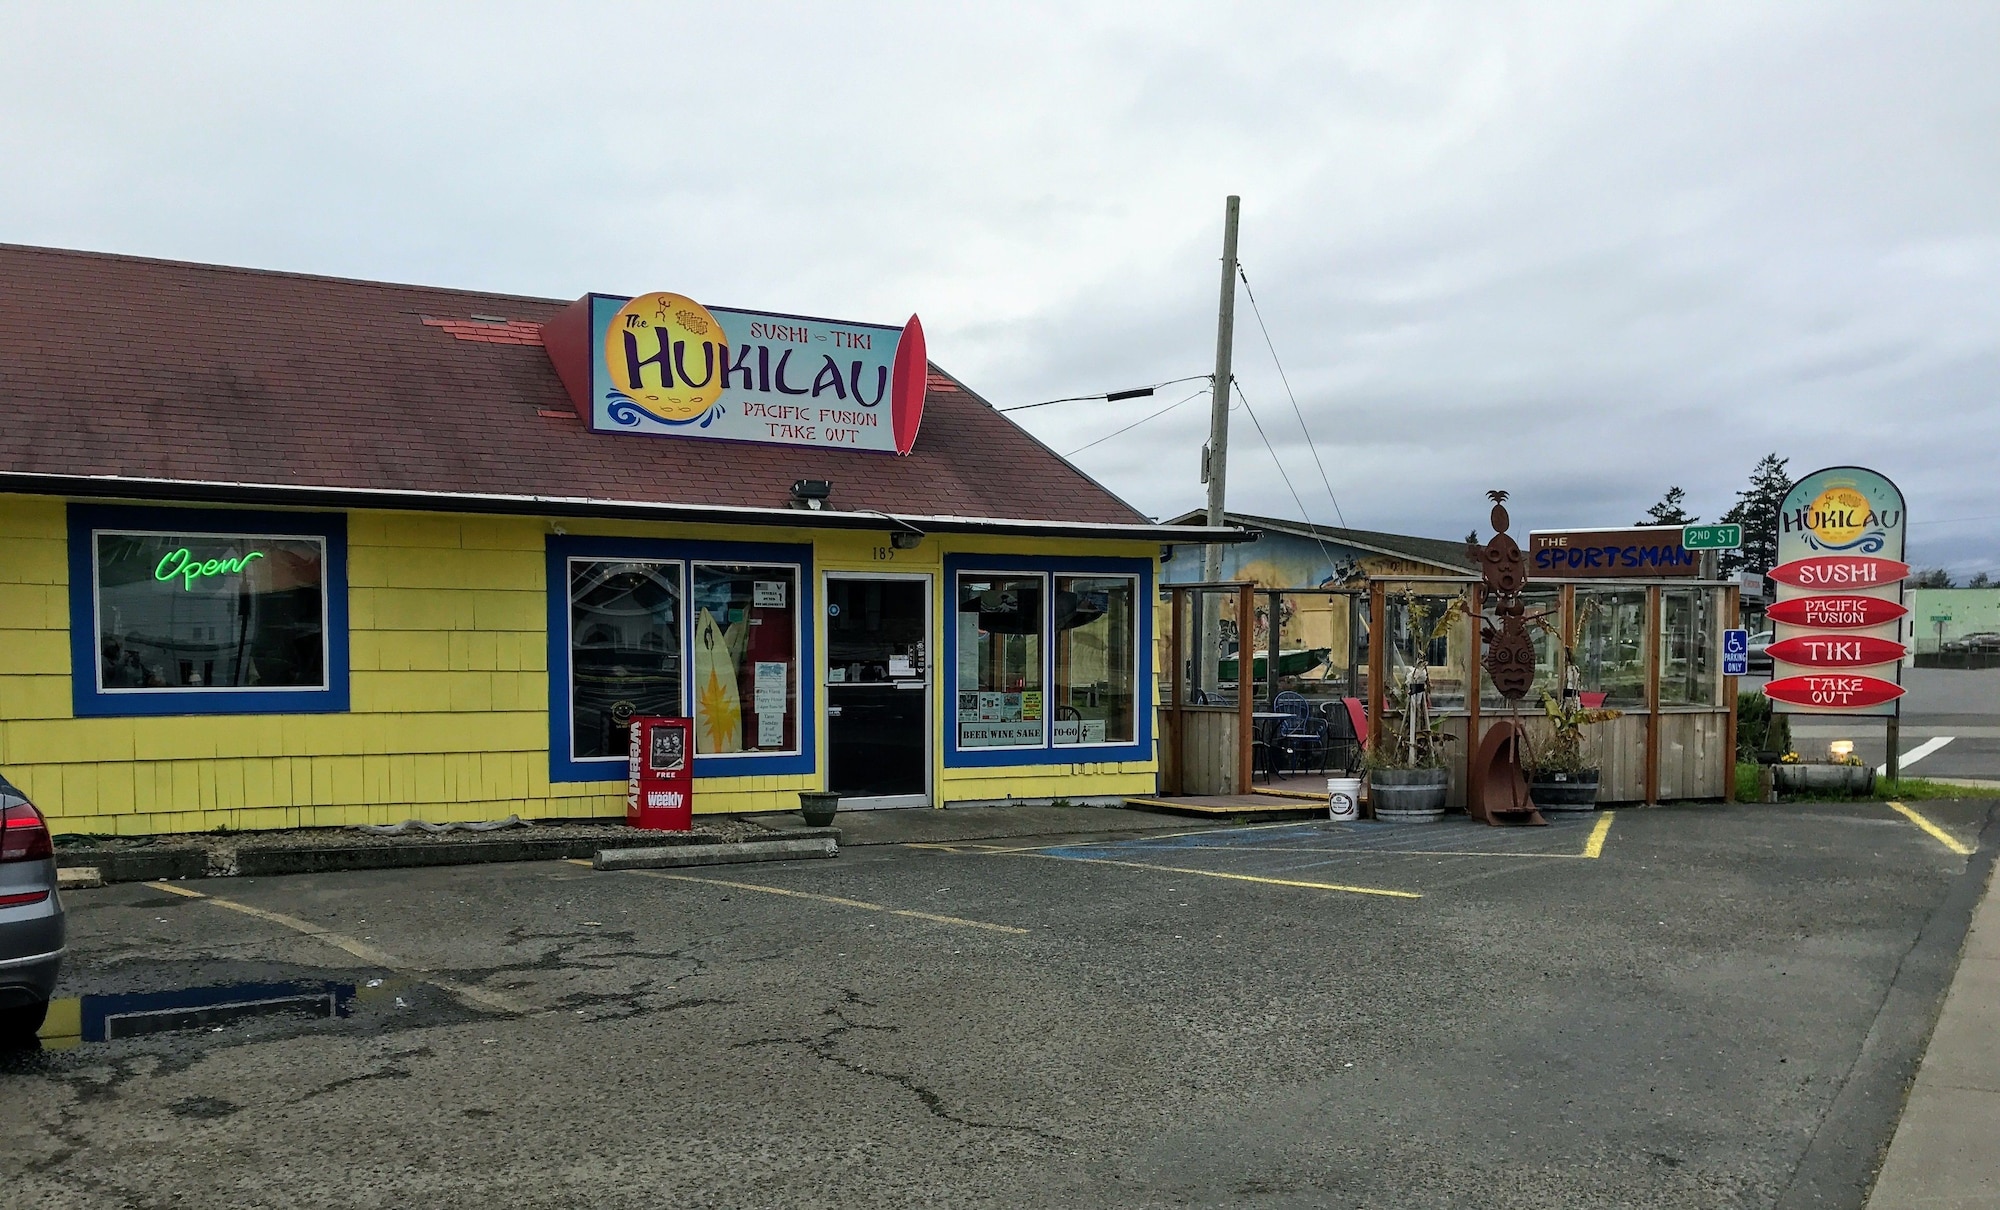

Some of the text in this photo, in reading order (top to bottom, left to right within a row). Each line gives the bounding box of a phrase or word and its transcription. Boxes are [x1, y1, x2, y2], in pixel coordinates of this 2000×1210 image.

[625, 314, 648, 328] The
[750, 322, 872, 350] SUSHI TIKI
[622, 326, 887, 407] HUKILAU
[743, 401, 878, 427] PACIFIC FUSION
[765, 423, 860, 443] TAKE OUT
[1783, 508, 1900, 533] HUKILAU
[1538, 537, 1568, 547] THE
[1689, 529, 1736, 545] 2ND ST
[872, 547, 894, 560] 185
[1535, 545, 1693, 569] SPORTSMAN
[154, 548, 264, 592] Open
[1799, 563, 1877, 584] SUSHI
[1805, 600, 1868, 612] PACIFIC
[1806, 612, 1865, 624] FUSION
[1724, 652, 1746, 662] PARKING
[1802, 642, 1862, 661] TIKI
[1728, 663, 1742, 672] ONLY
[1804, 677, 1863, 692] TAKE
[1811, 691, 1854, 704] OUT
[963, 729, 1041, 739] BEER WINE SAKE
[1054, 728, 1078, 736] TO-GO
